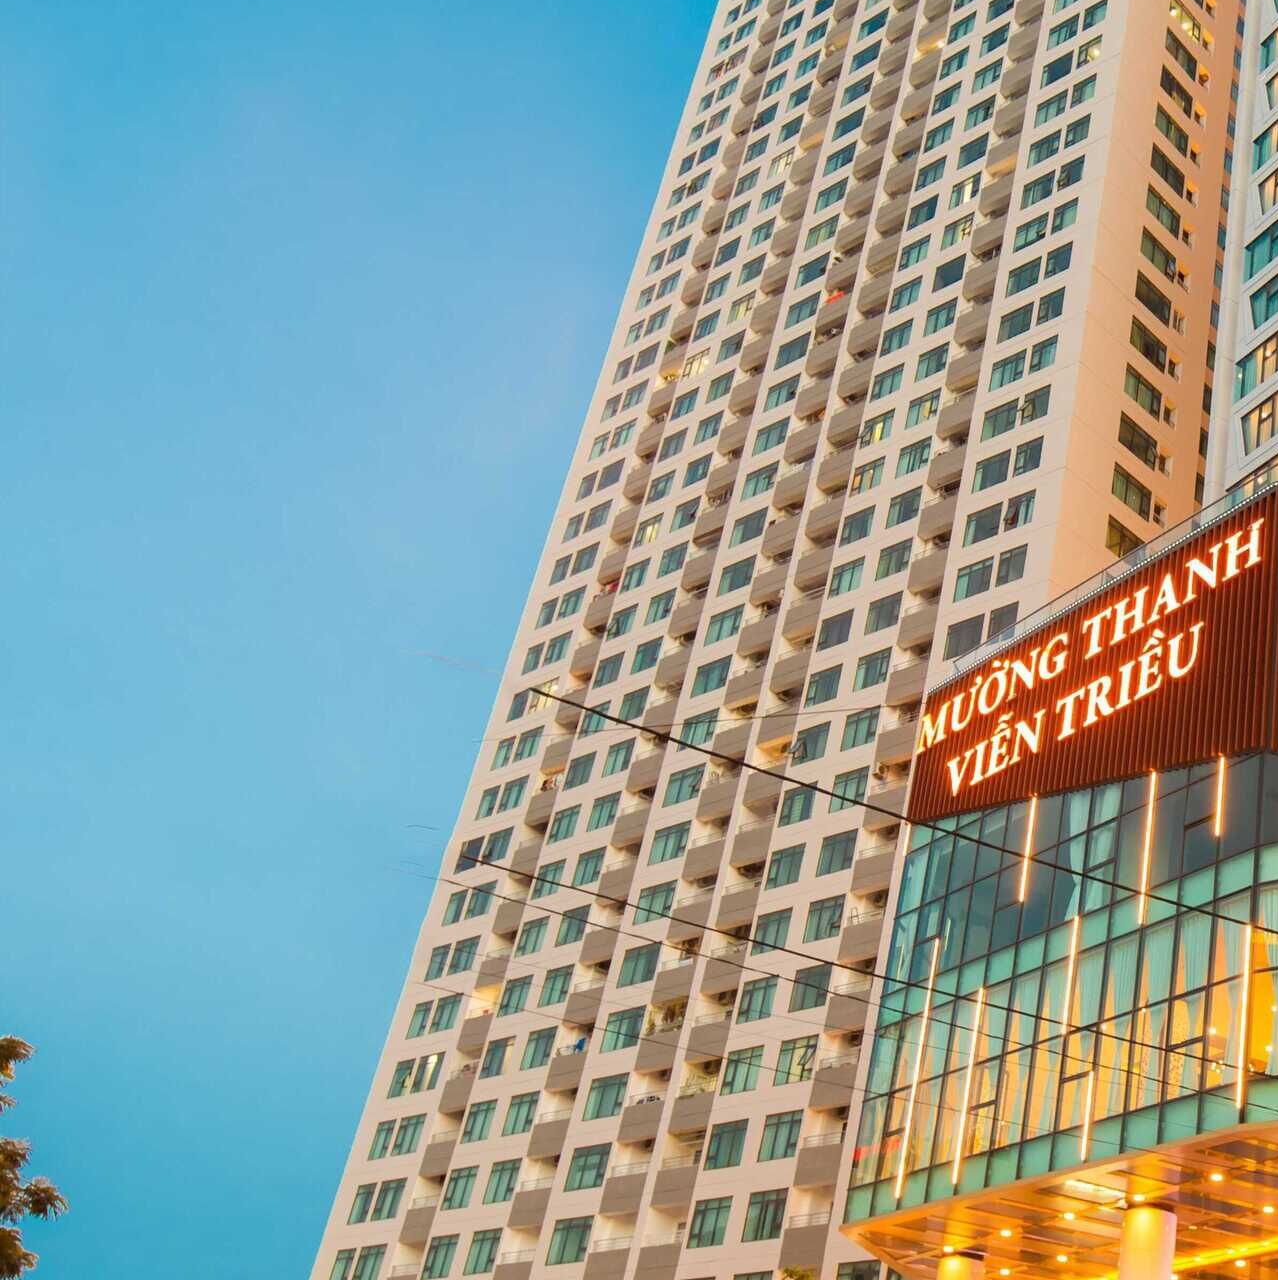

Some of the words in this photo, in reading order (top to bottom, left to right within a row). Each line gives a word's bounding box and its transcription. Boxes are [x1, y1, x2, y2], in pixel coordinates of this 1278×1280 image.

[915, 631, 1070, 756] MƯỜNG
[1080, 517, 1265, 661] THANH
[1055, 621, 1205, 742] TRIỀU
